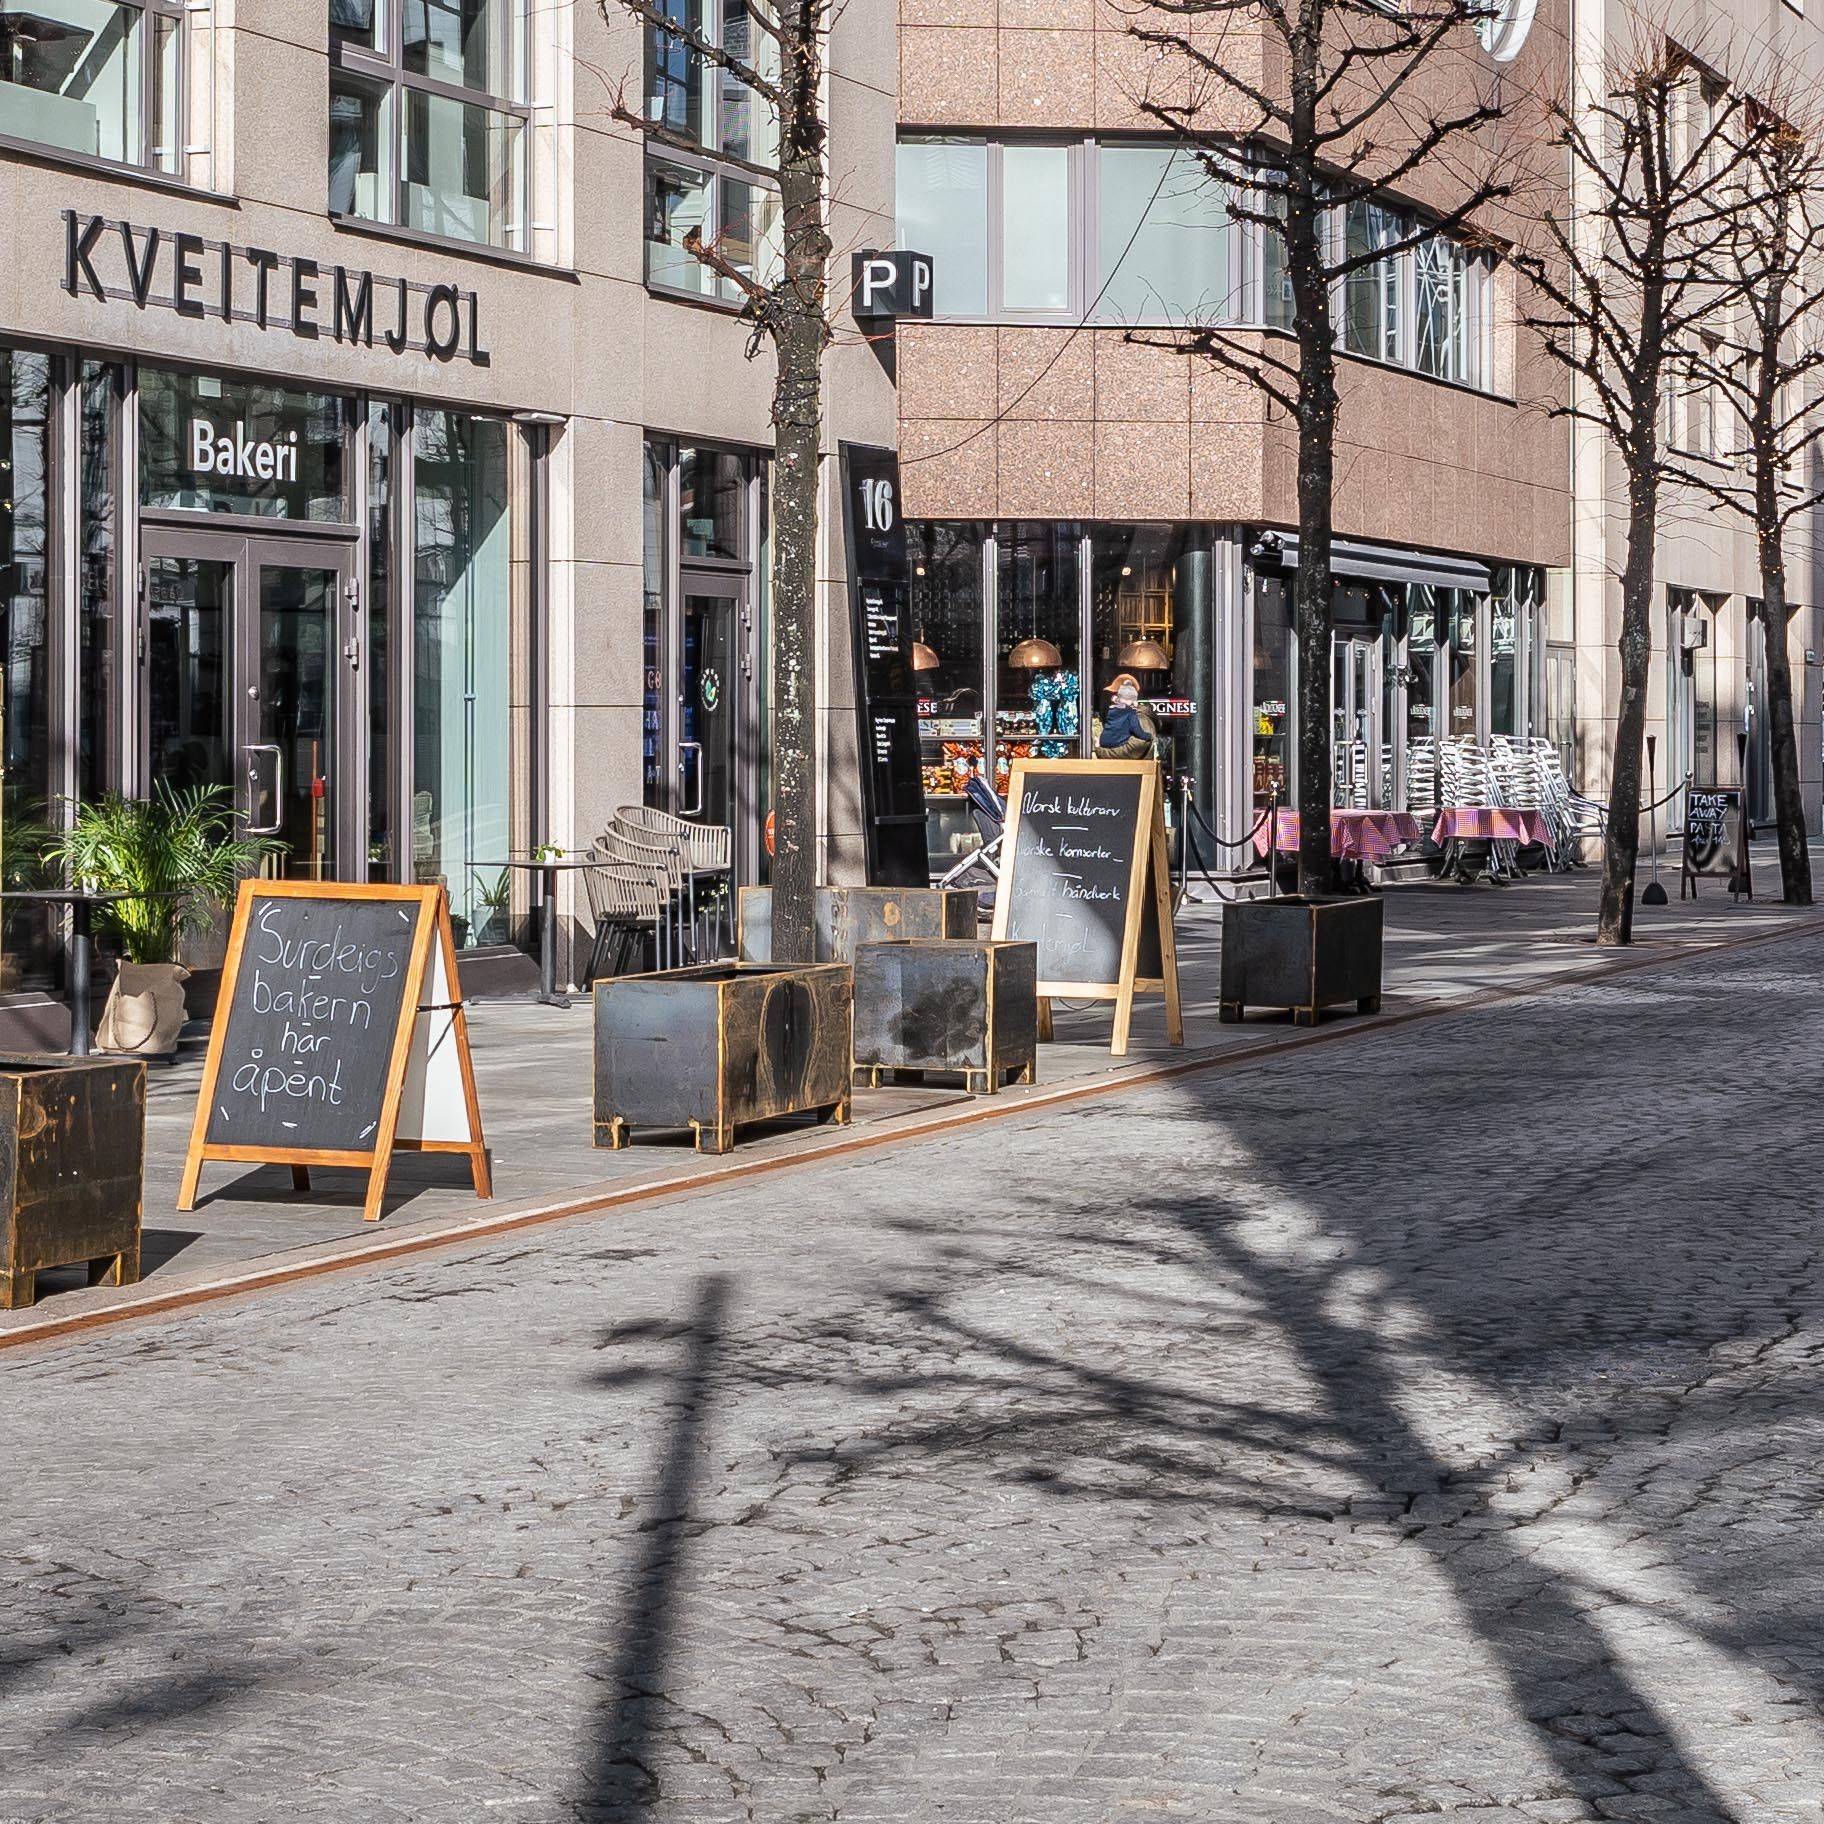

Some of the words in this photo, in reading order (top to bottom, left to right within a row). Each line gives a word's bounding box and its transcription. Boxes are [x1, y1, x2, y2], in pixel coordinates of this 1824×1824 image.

[67, 208, 491, 367] KVEITEMJØL
[863, 259, 896, 306] P
[912, 259, 931, 307] P
[192, 419, 297, 483] Bakeri
[858, 478, 893, 532] 16
[916, 702, 938, 714] ESE
[1022, 791, 1062, 816] Norsk
[1688, 807, 1728, 819] AWAY
[1689, 793, 1729, 807] TAKE
[1689, 822, 1729, 835] PASTA
[258, 907, 399, 994] Surdeigs
[253, 969, 371, 1029] bakern
[281, 1022, 332, 1053] har
[232, 1048, 343, 1113] åpent
